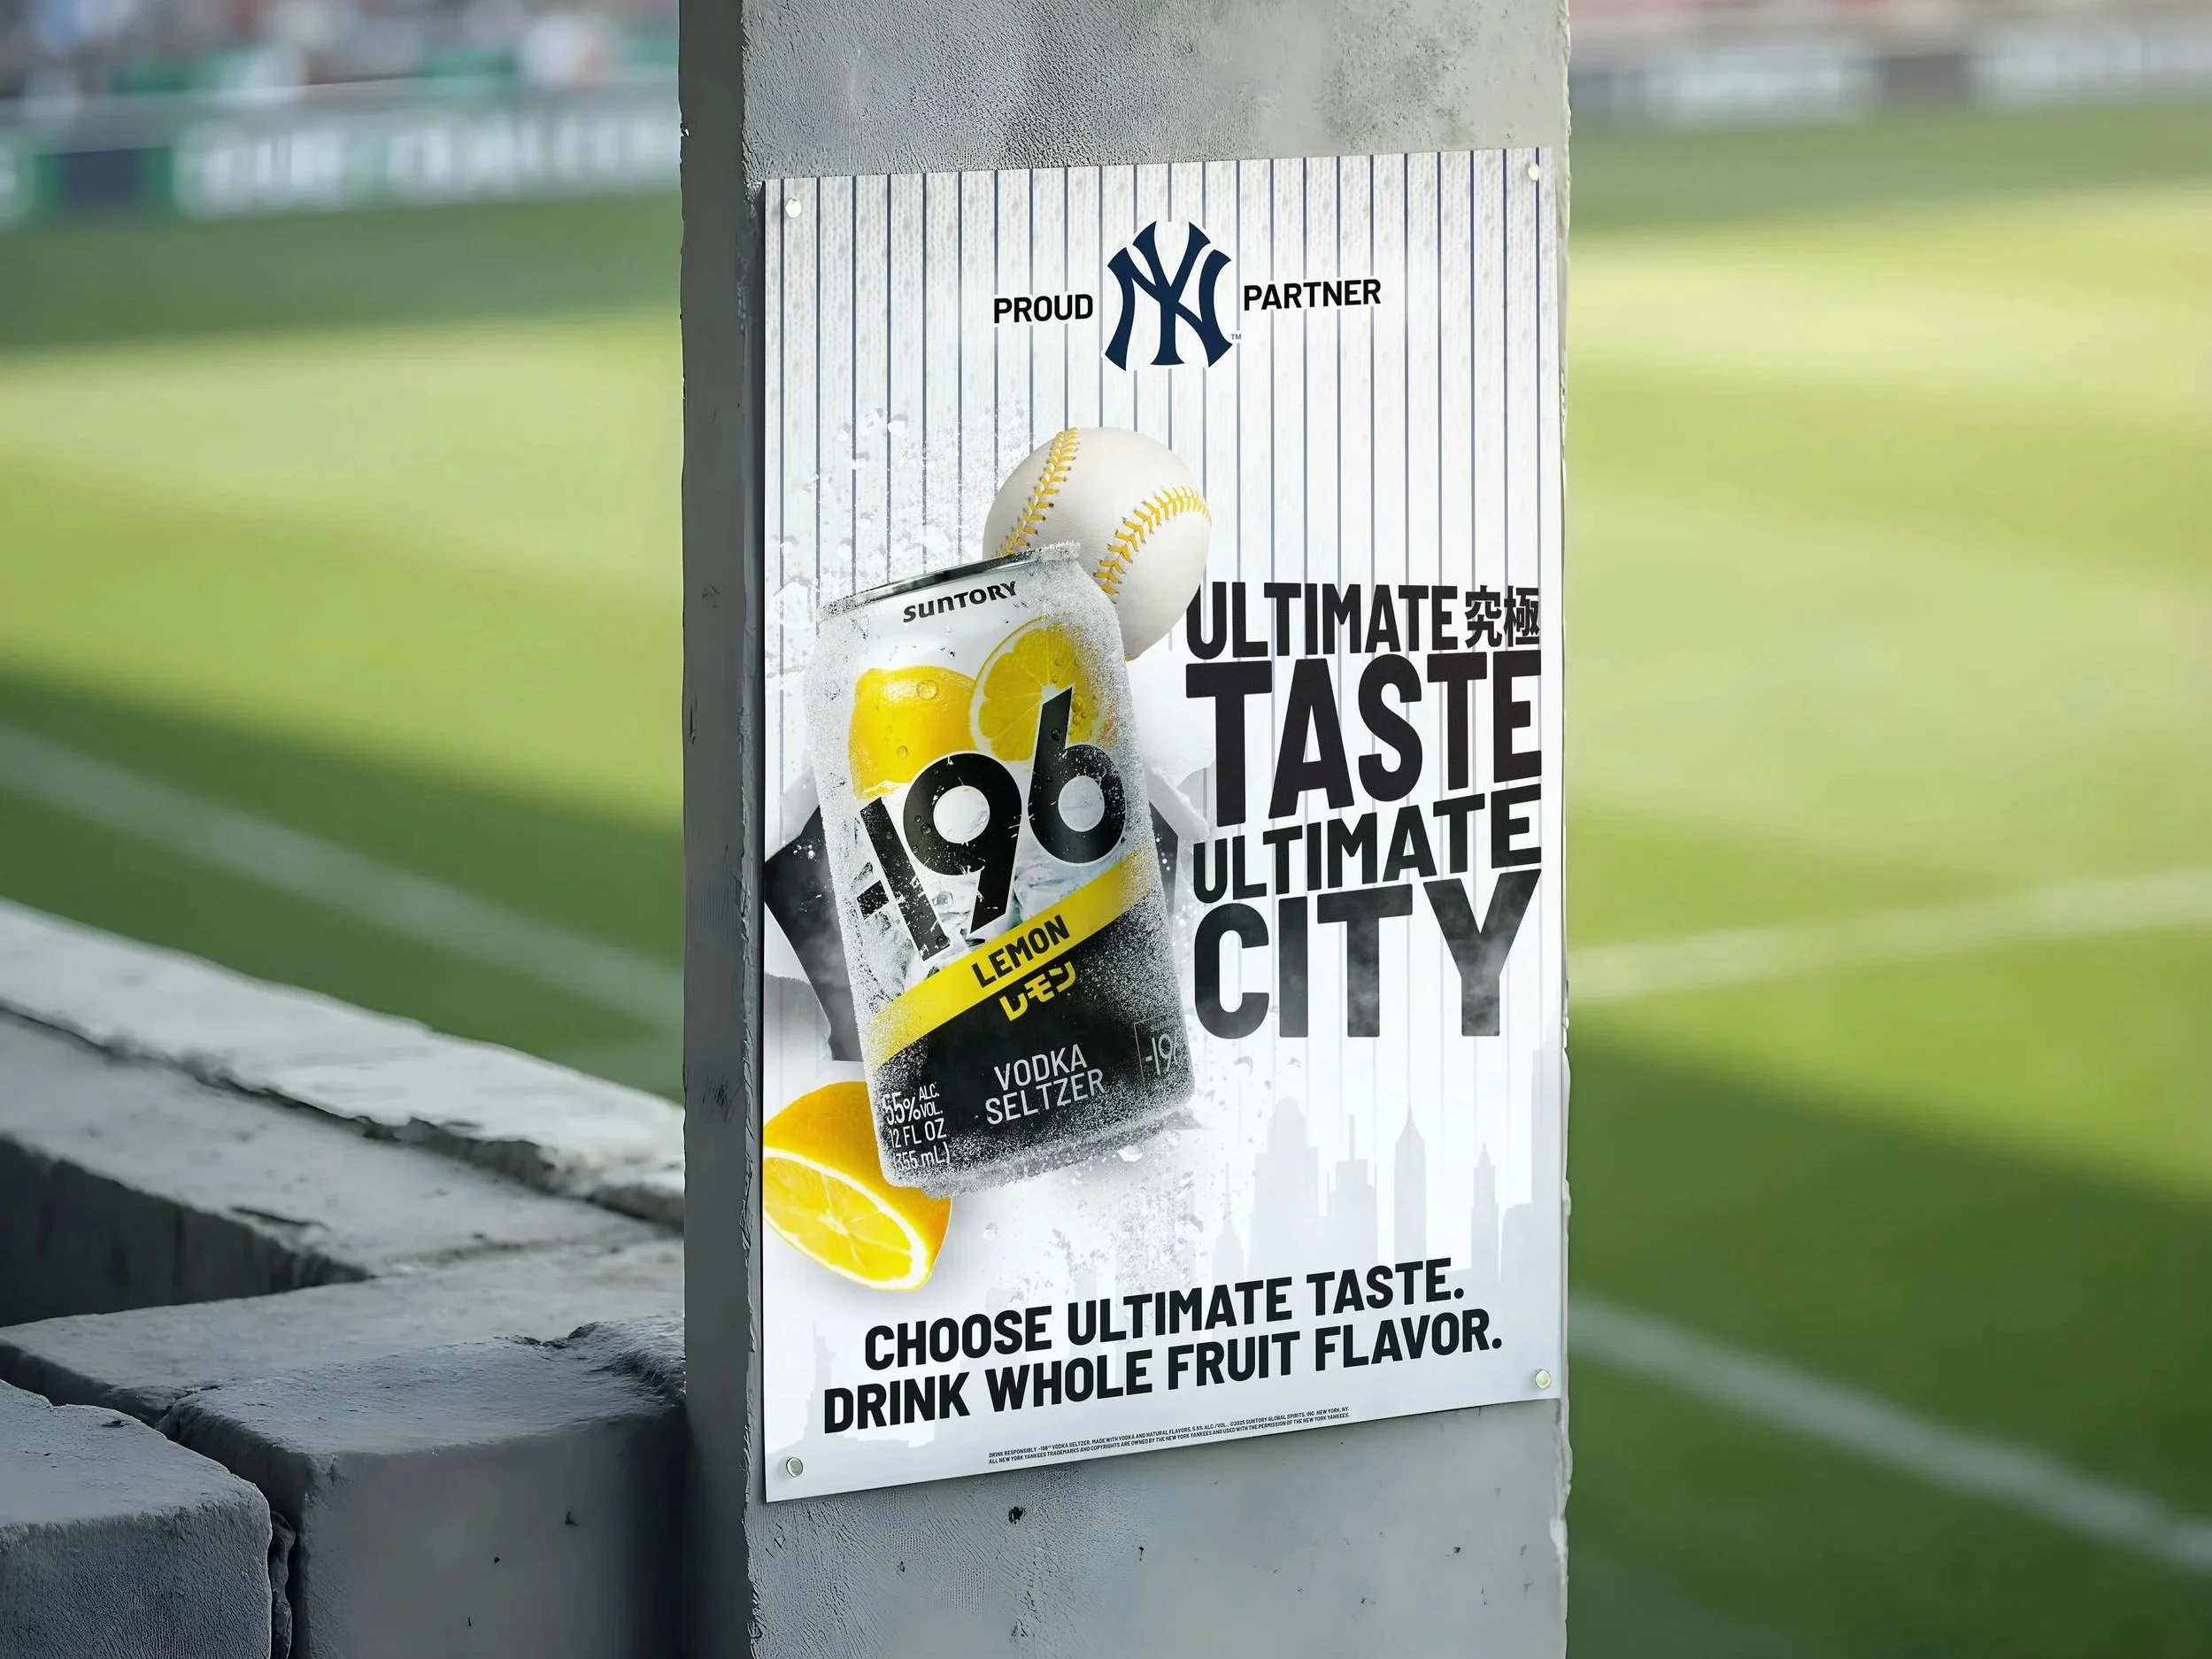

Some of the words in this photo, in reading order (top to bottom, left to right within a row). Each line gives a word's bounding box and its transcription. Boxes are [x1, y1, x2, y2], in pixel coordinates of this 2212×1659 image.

[993, 293, 1094, 324] PROUD
[1243, 279, 1382, 311] PARTNER
[903, 580, 1017, 623] SUNTORY
[1186, 581, 1458, 660] ULTIMATE
[1464, 584, 1540, 649] 究極
[1185, 649, 1542, 828] TASTE
[857, 686, 1126, 963] -196
[1193, 783, 1542, 904] ULTIMATE
[971, 914, 1071, 989] LEMON
[1194, 868, 1542, 1039] CITY
[998, 961, 1077, 1022] レモン
[919, 1084, 940, 1101] ALC.
[984, 1068, 1106, 1125] SELTZER
[993, 1043, 1088, 1092] VODKA
[889, 1128, 902, 1149] 12
[903, 1125, 922, 1146] FL
[924, 1117, 947, 1141] OZ
[920, 1101, 944, 1118] VOL.
[921, 1141, 951, 1168] mL)
[864, 1305, 1052, 1371] CHOOSE
[1067, 1277, 1292, 1346] ULTIMATE
[1306, 1257, 1465, 1317] TASTE.
[824, 1371, 971, 1434] DRINK
[985, 1349, 1152, 1413] WHOLE
[1168, 1331, 1300, 1390] FRUIT
[1315, 1308, 1503, 1372] FLAVOR.
